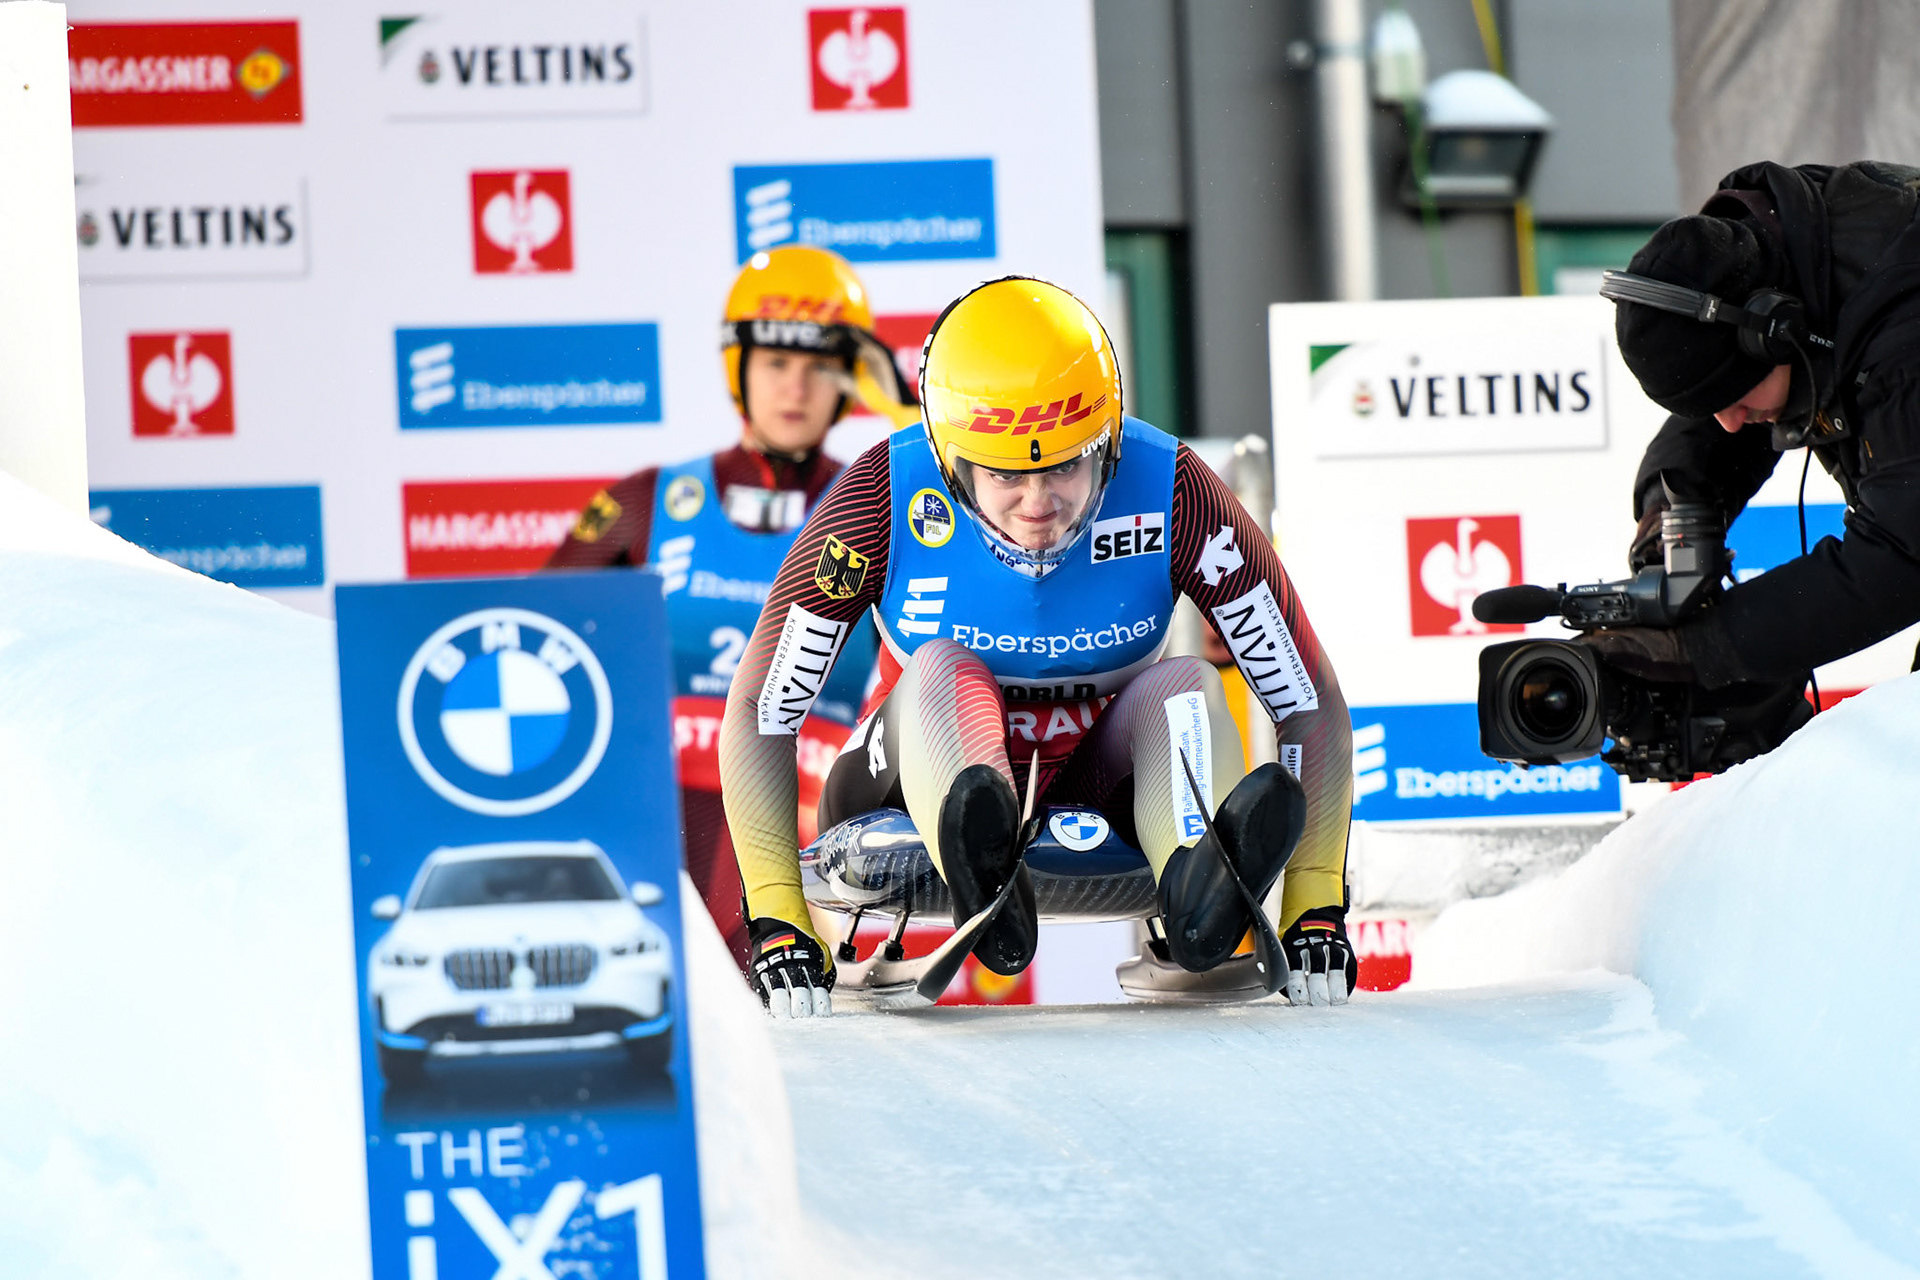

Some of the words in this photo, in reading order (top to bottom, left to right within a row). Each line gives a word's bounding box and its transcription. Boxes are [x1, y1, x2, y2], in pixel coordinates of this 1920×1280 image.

[452, 44, 633, 84] VELTINS
[111, 205, 294, 247] VELTINS
[751, 318, 826, 347] uve
[967, 392, 1093, 436] DHL
[1390, 371, 1590, 417] VELTINS
[1081, 425, 1112, 459] uvex
[925, 523, 942, 536] FIL
[1577, 585, 1600, 593] SONY
[425, 621, 581, 683] BMW
[952, 614, 1157, 658] Eberspächer
[1262, 592, 1313, 701] KOFFERMANUFAKTUR
[1223, 604, 1298, 720] TITAN
[999, 683, 1096, 702] ORLD
[1187, 697, 1199, 710] eG
[395, 1126, 526, 1180] THE
[404, 1173, 668, 1280] iX1
